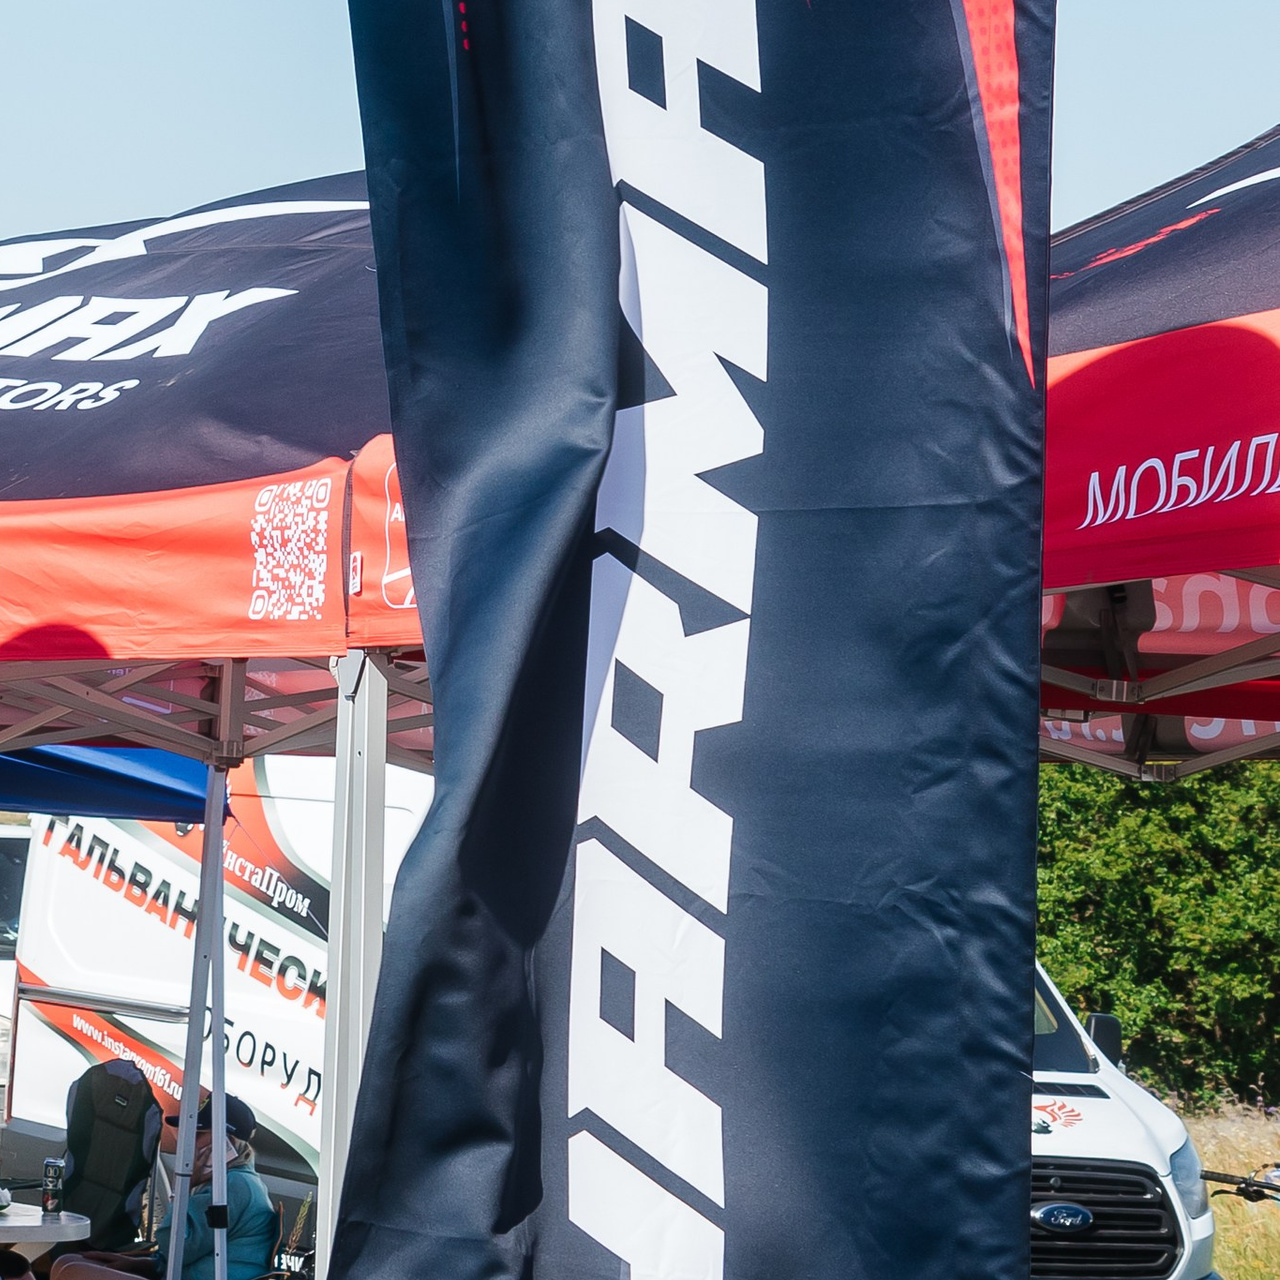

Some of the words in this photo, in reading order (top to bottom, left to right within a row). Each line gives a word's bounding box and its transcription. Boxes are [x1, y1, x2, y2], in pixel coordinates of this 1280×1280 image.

[1075, 433, 1280, 531] МОБИЛ
[42, 816, 329, 1021] ГАЛЬВАНЧЕСК
[1051, 1208, 1083, 1226] Ford
